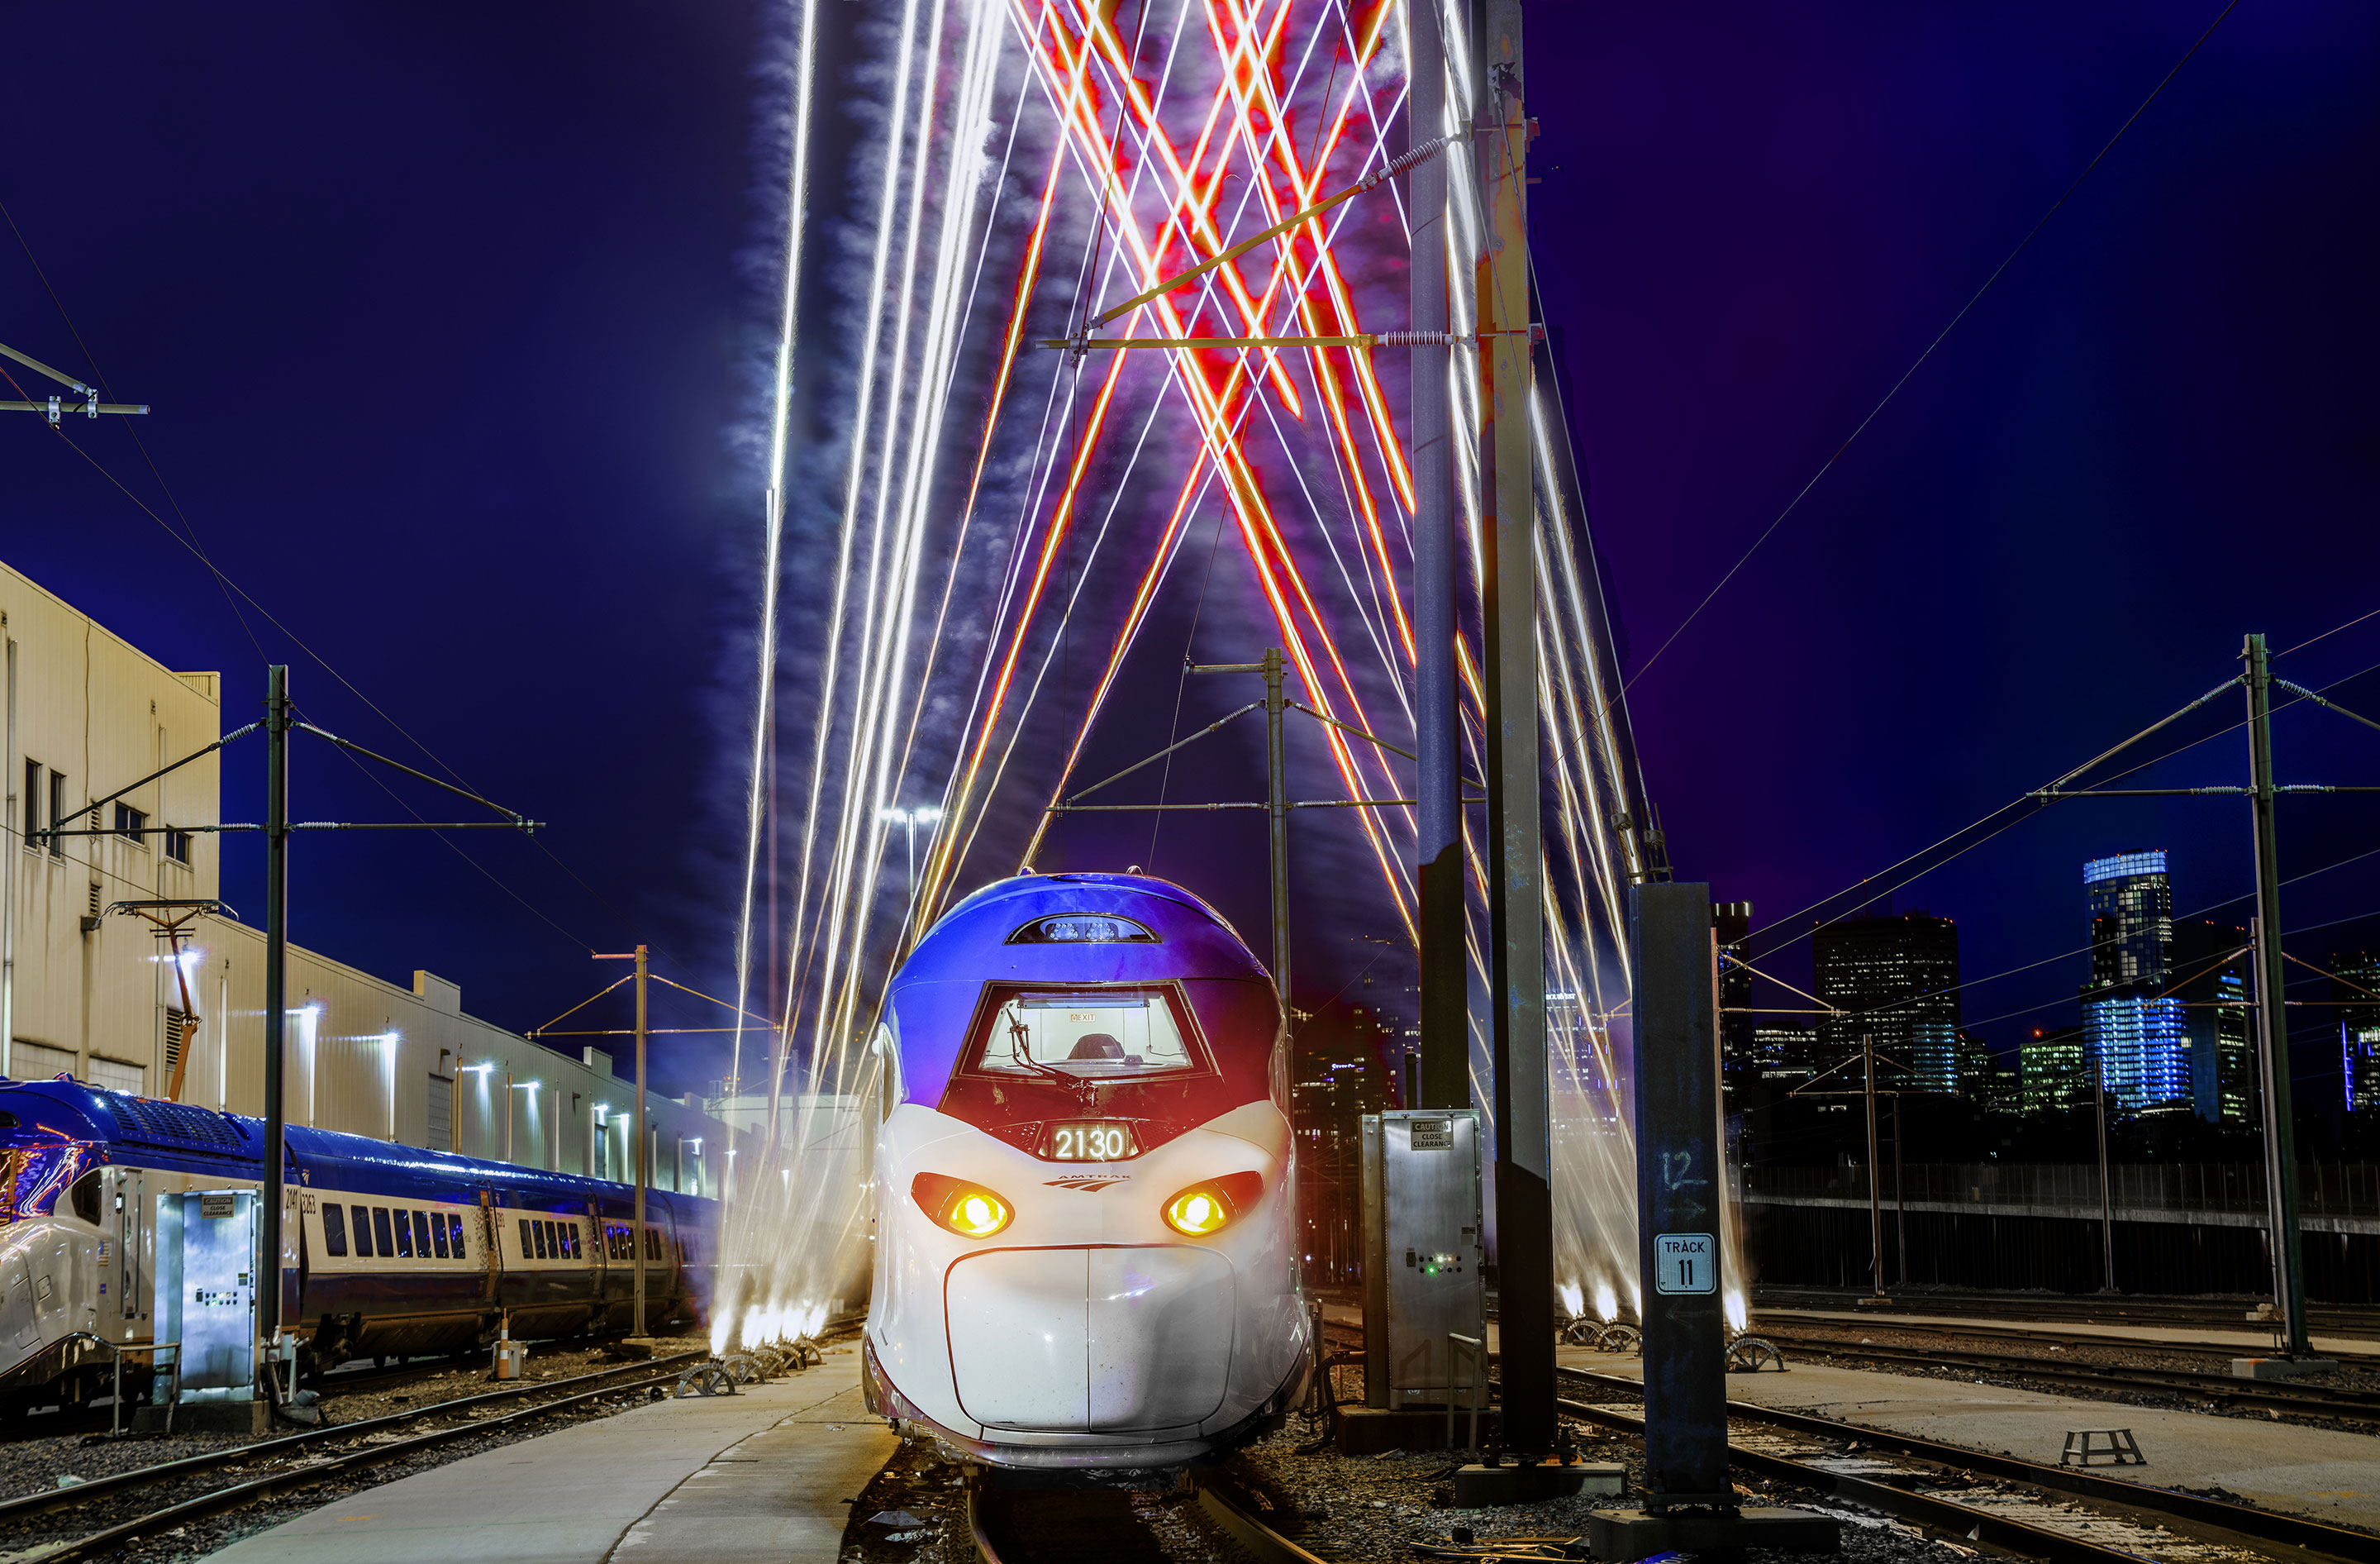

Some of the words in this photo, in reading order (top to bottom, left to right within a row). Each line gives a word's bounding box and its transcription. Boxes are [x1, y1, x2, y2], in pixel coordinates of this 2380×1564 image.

[1056, 1130, 1122, 1157] 2130
[1662, 1151, 1708, 1191] 12
[1665, 1242, 1706, 1253] TRACK
[1678, 1260, 1693, 1285] 11
